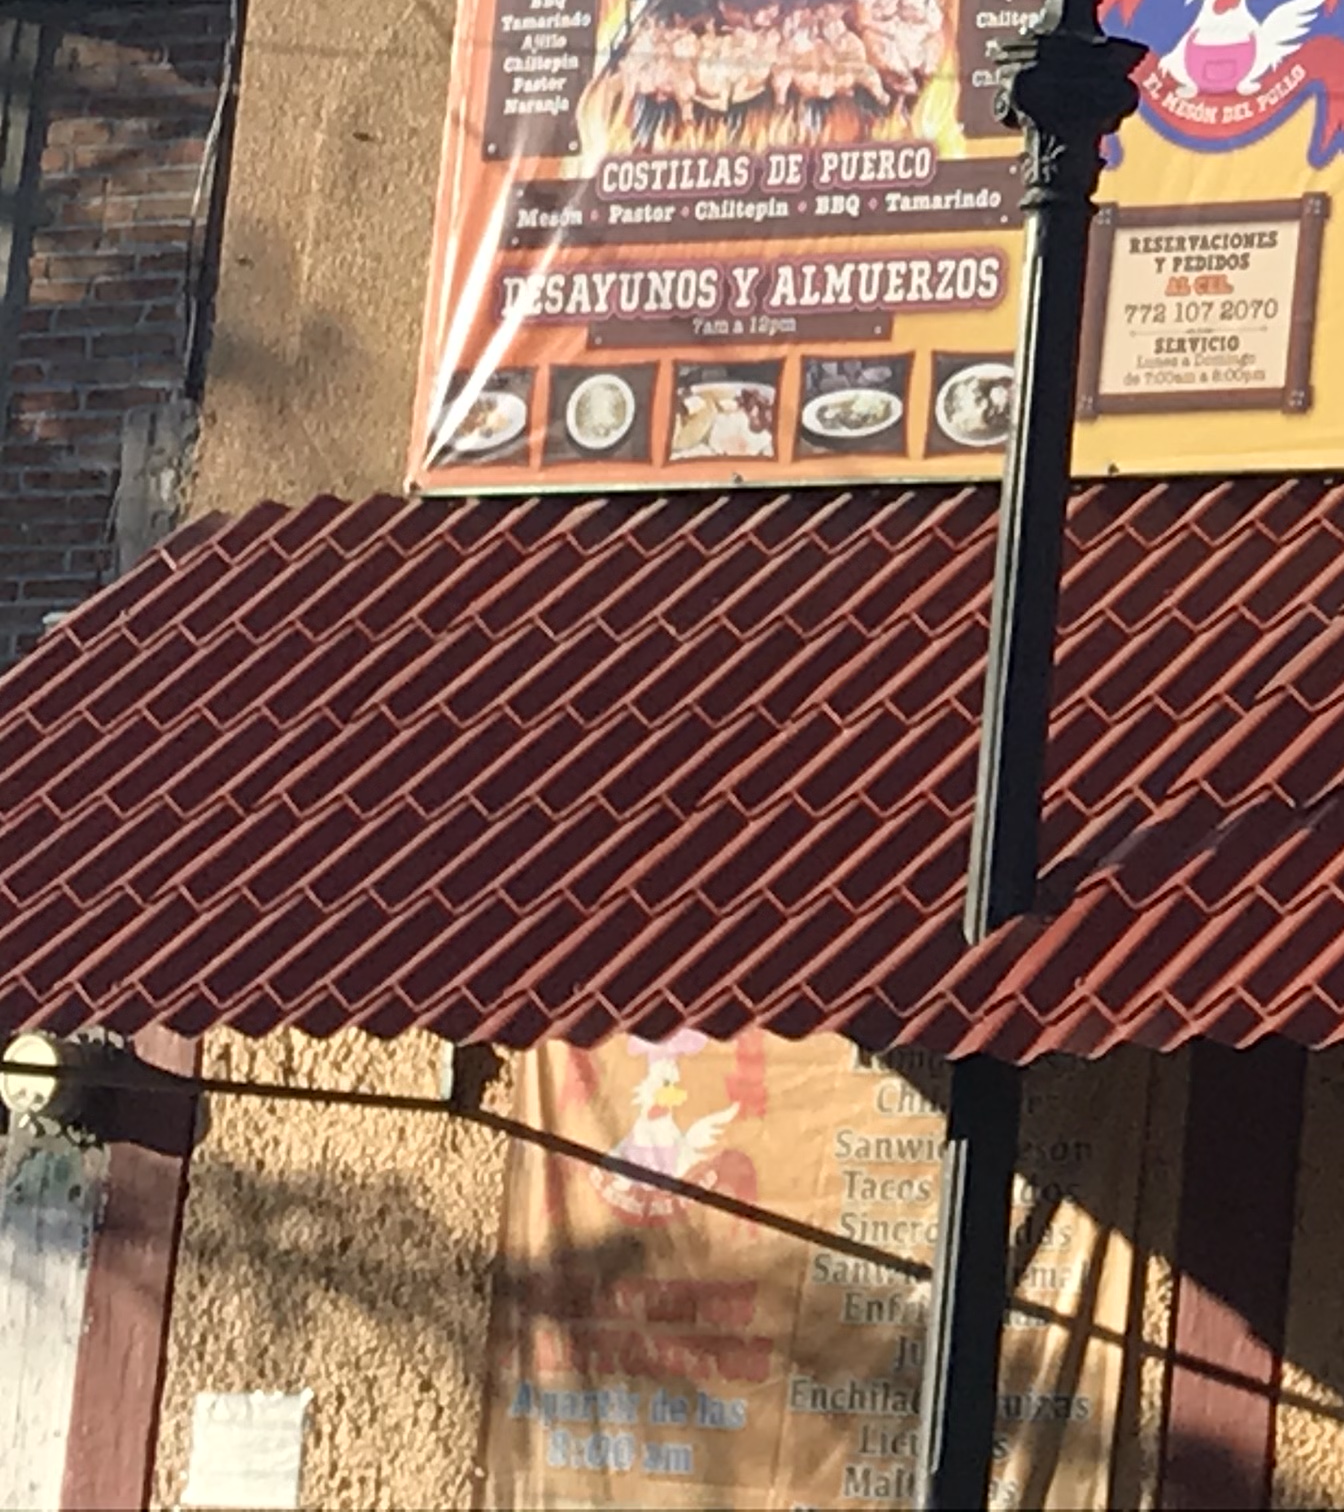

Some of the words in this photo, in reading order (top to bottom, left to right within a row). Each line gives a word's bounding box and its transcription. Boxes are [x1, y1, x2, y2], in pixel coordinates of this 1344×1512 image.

[501, 11, 592, 33] Tamarindo
[512, 76, 567, 94] Pastor
[1142, 72, 1164, 100] EL
[1161, 91, 1218, 124] MESÓN
[1221, 101, 1255, 124] DEL
[1256, 63, 1307, 113] POLLO
[602, 155, 750, 193] COSTILLAS
[766, 152, 803, 186] DE
[818, 147, 932, 184] PUERCO
[607, 203, 676, 224] Pastor
[814, 194, 861, 218] BBQ
[884, 188, 1002, 213] Tamarindo
[1128, 230, 1279, 254] RESERVACIONES
[1153, 256, 1167, 274] Y
[1172, 252, 1251, 273] PEDIDOS
[501, 268, 719, 318] DESAYUNOS
[732, 266, 760, 309] Y
[768, 256, 1000, 308] ALMUERZOS
[1124, 303, 1167, 324] 772
[1174, 300, 1214, 324] 107
[1218, 297, 1280, 322] 2070
[1153, 334, 1241, 355] SERVICIO
[843, 1169, 933, 1204] Tacos
[651, 1388, 688, 1425] de
[696, 1389, 748, 1429] las
